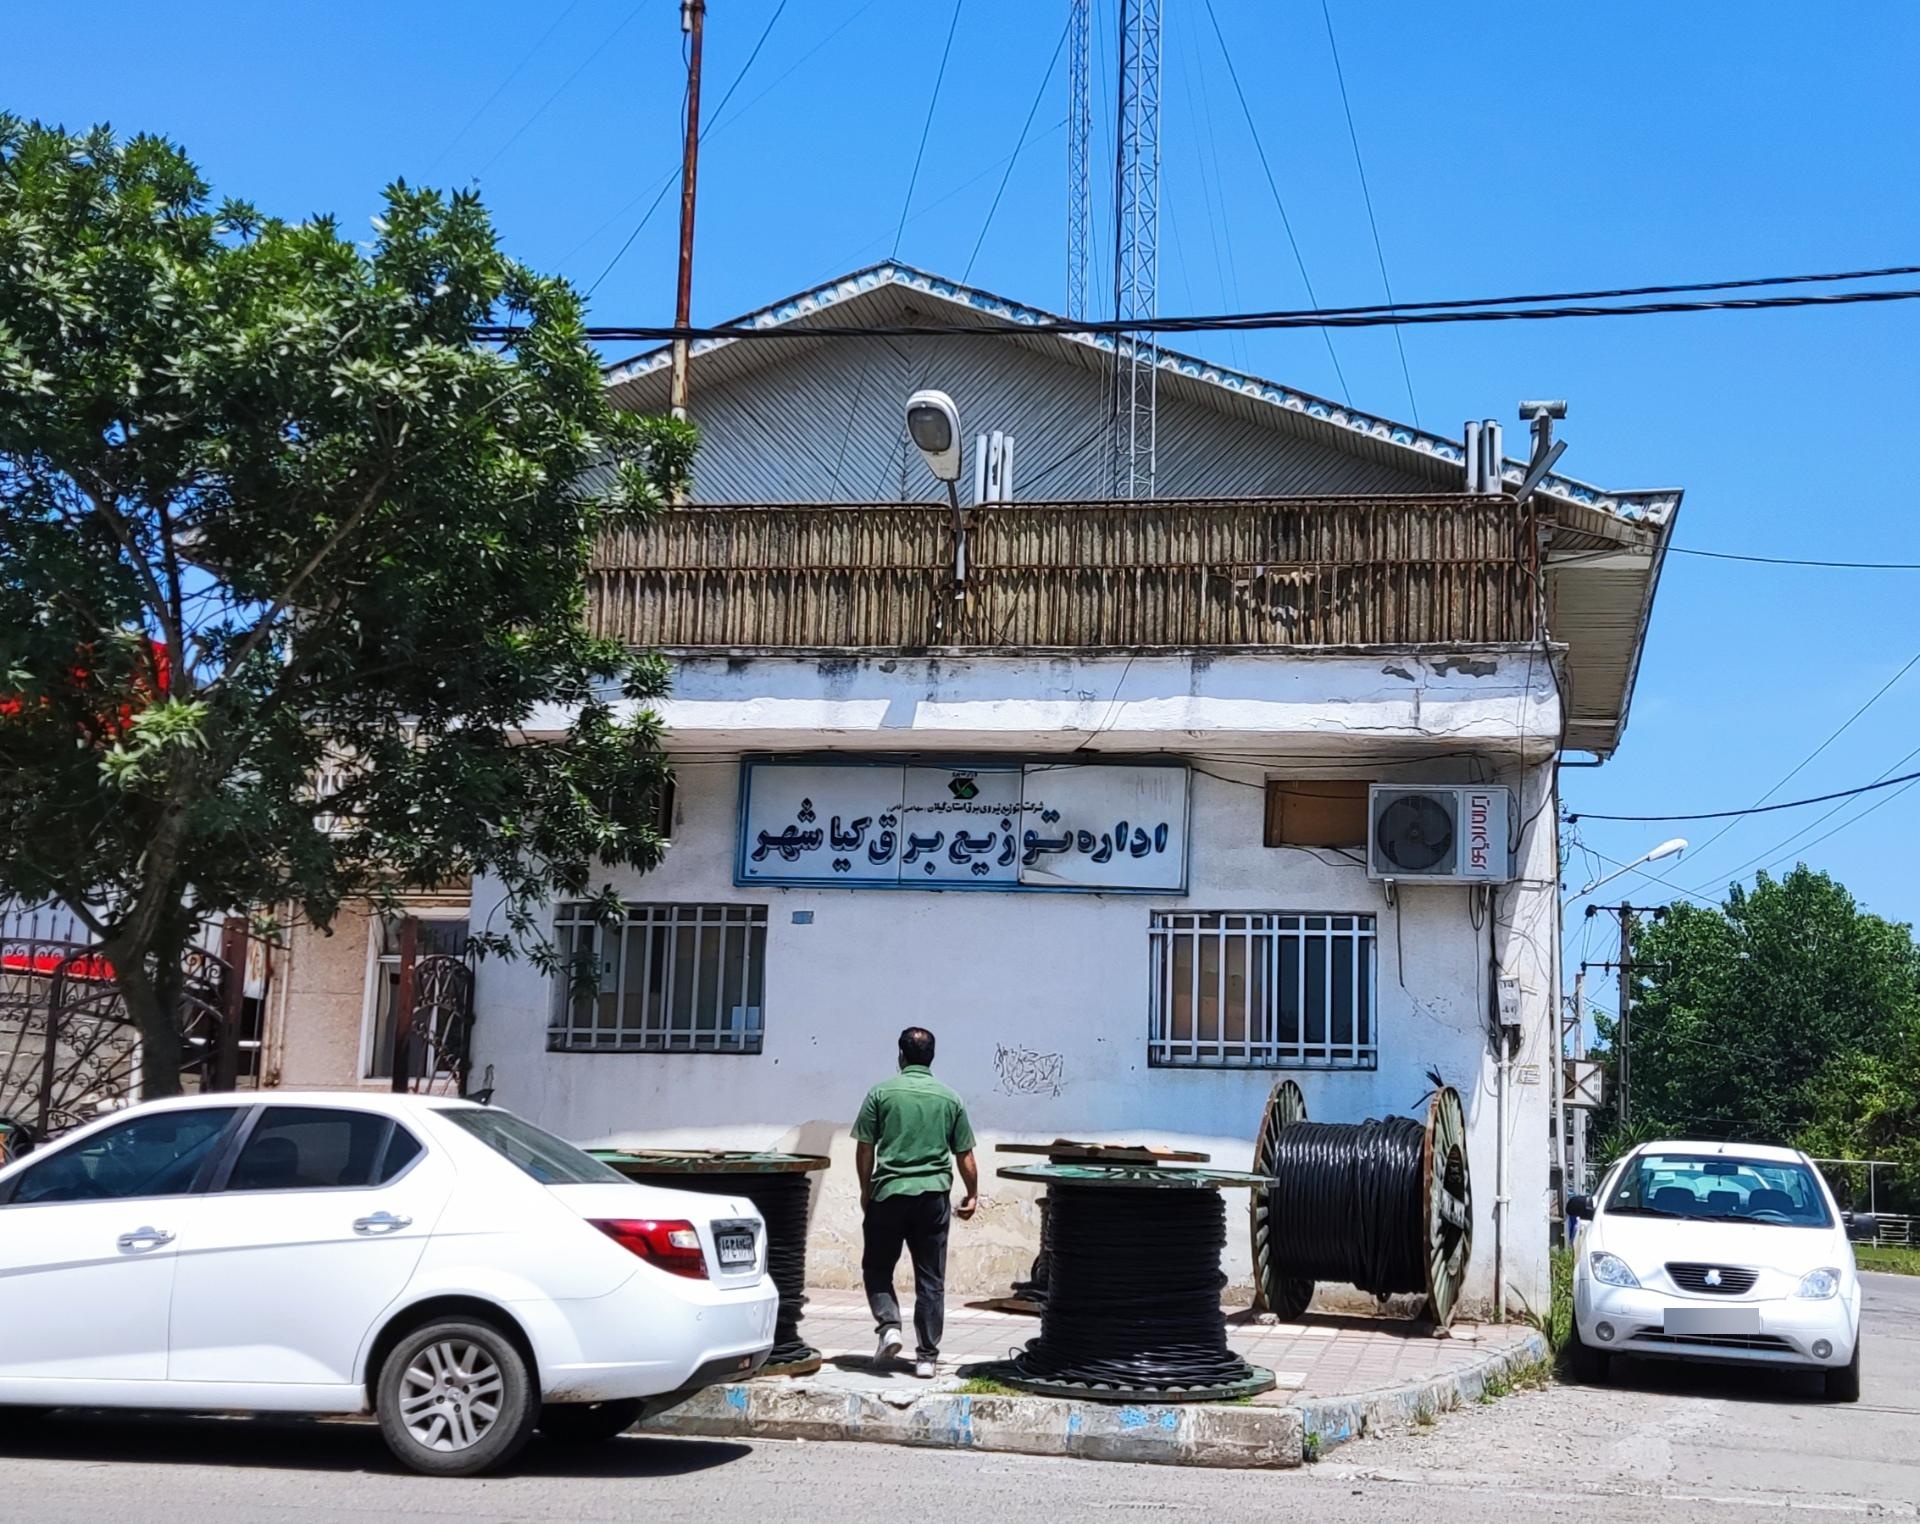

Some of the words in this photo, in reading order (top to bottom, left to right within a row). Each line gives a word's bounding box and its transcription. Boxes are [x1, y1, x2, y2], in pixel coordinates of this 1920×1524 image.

[1000, 802, 1020, 817] توزیع
[1022, 801, 1044, 814] شرکت
[868, 813, 945, 875] برق
[948, 809, 1074, 876] توزیع
[1077, 820, 1169, 864] اداره
